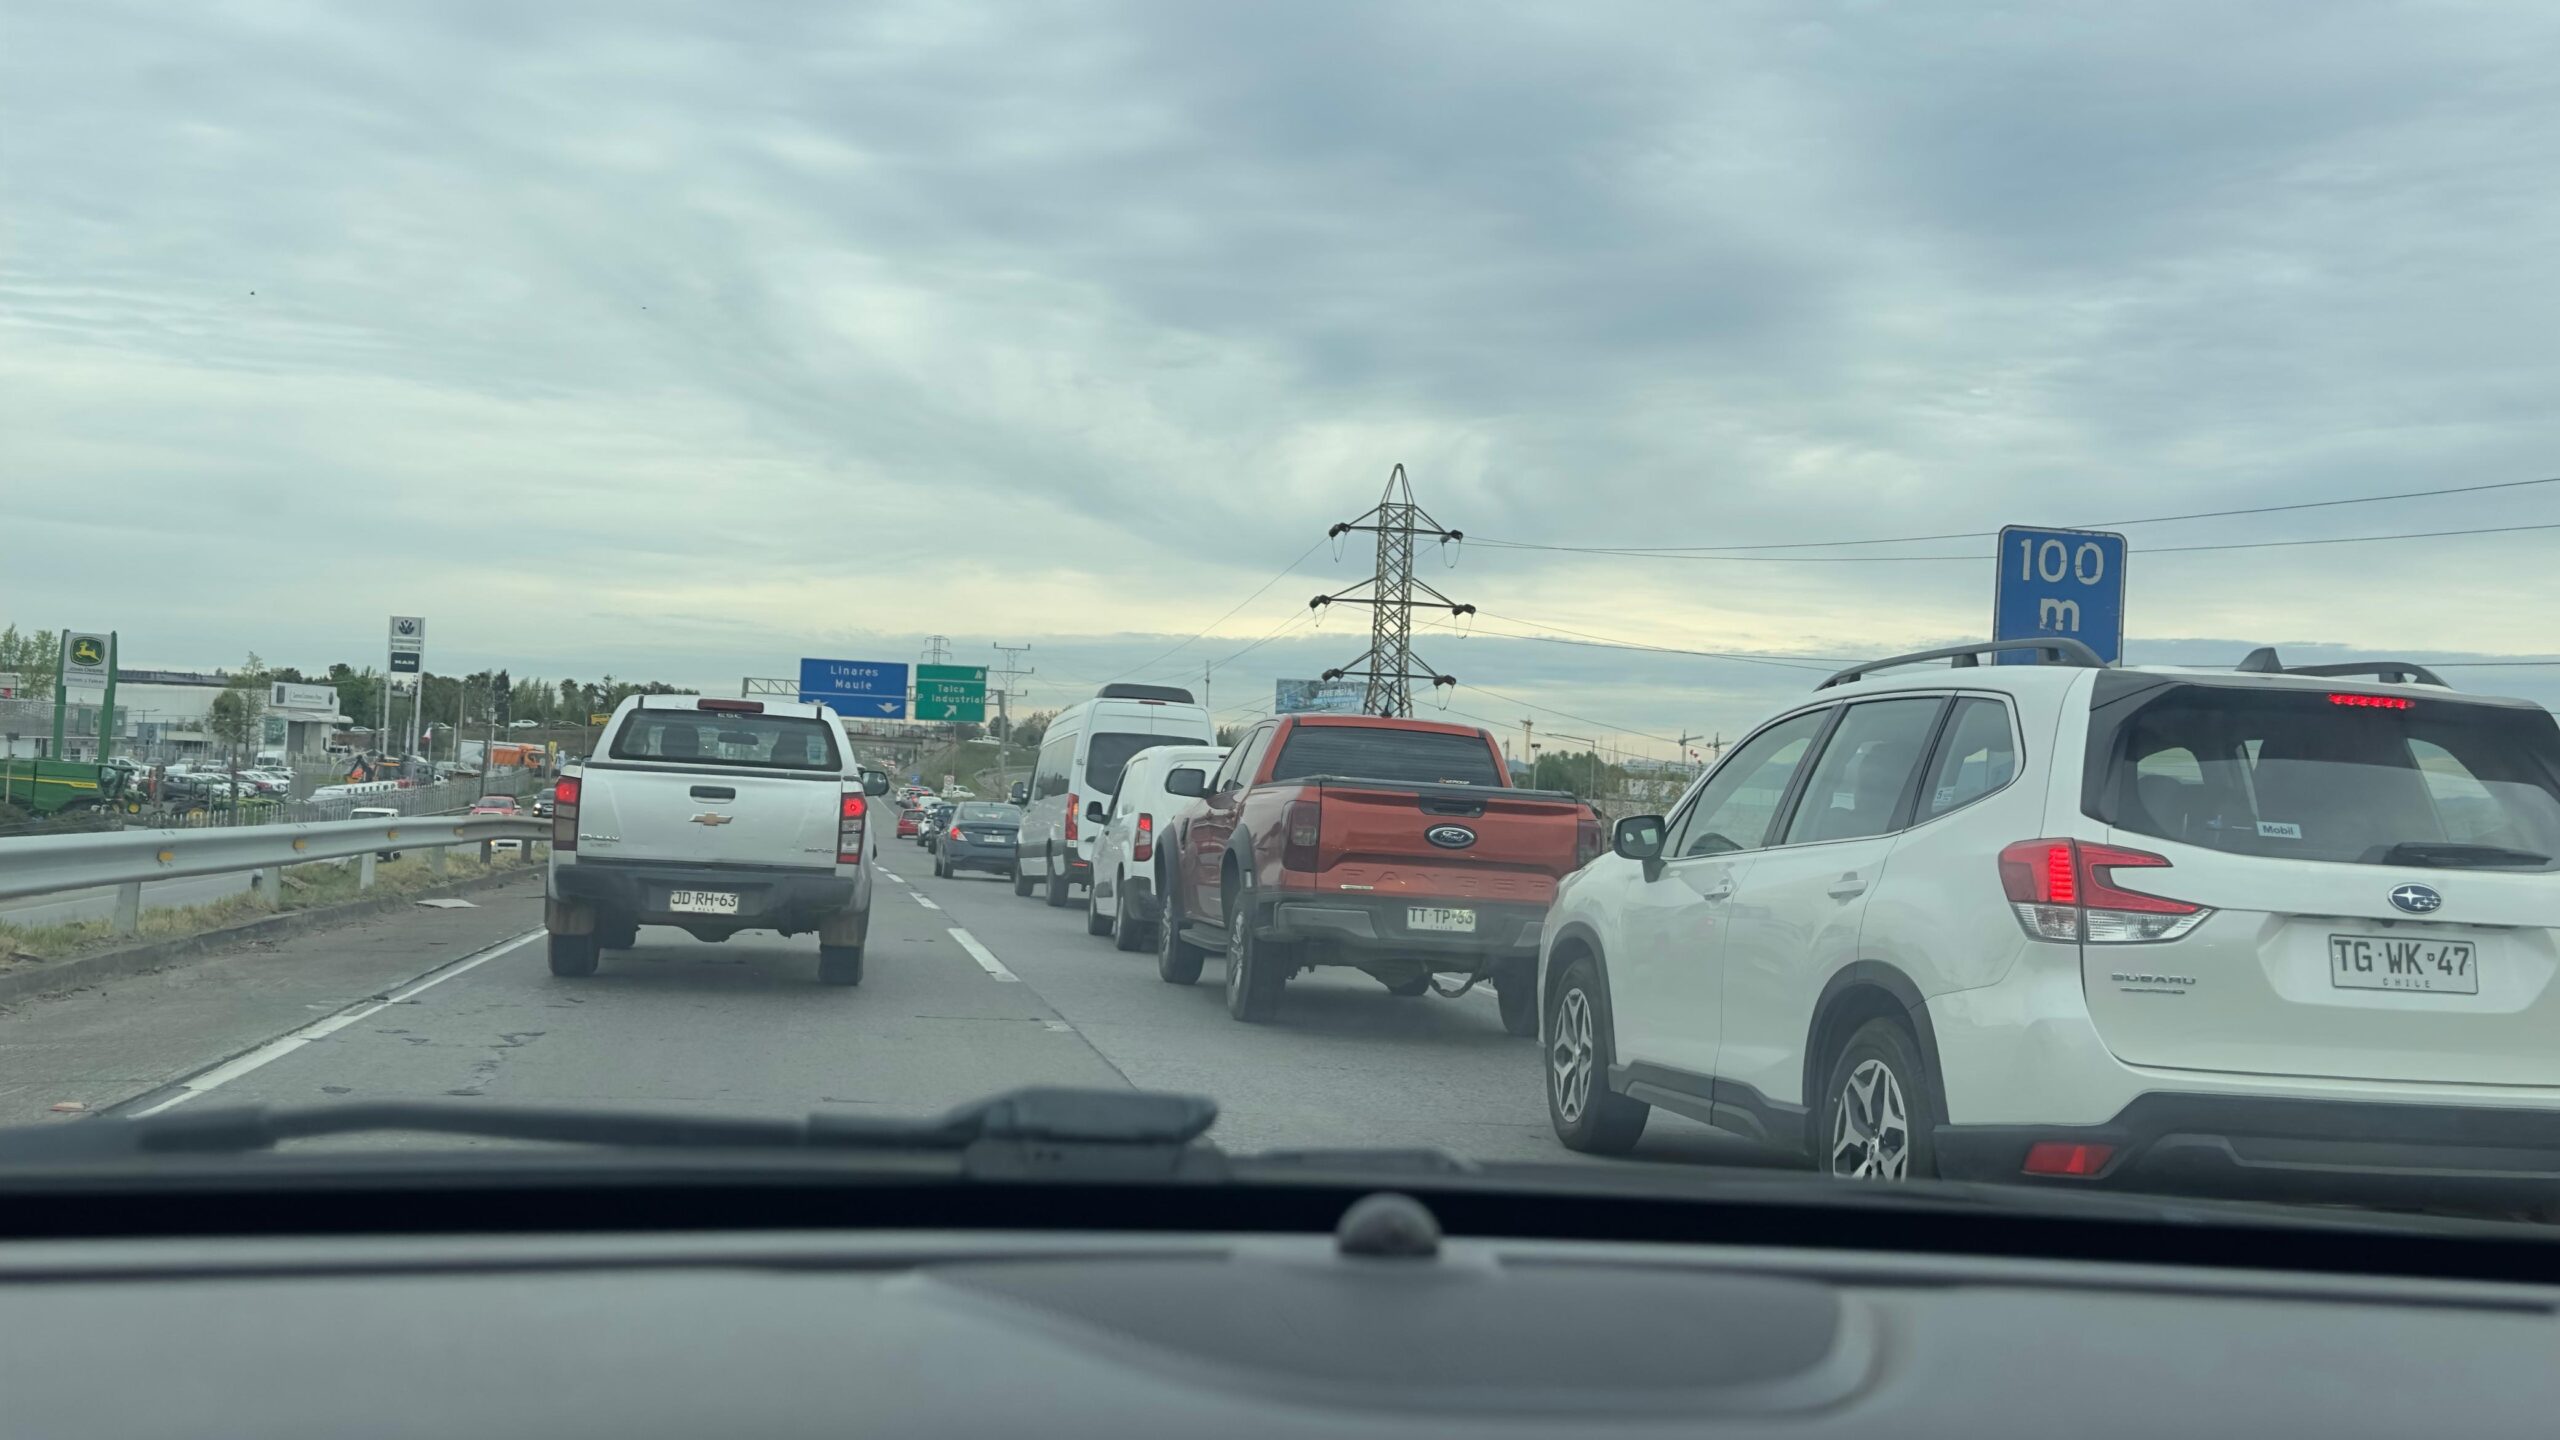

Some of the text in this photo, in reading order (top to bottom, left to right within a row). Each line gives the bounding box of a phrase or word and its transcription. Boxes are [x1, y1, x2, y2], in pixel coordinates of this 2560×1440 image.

[2021, 538, 2104, 586] 100
[2039, 598, 2080, 632] m
[830, 665, 879, 677] Linares
[836, 679, 872, 690] Maule
[938, 684, 965, 693] Talca
[917, 693, 985, 704] P Industrial
[2262, 824, 2294, 835] Mobil
[2111, 972, 2196, 985] SUBARU
[2382, 977, 2431, 988] CHILE
